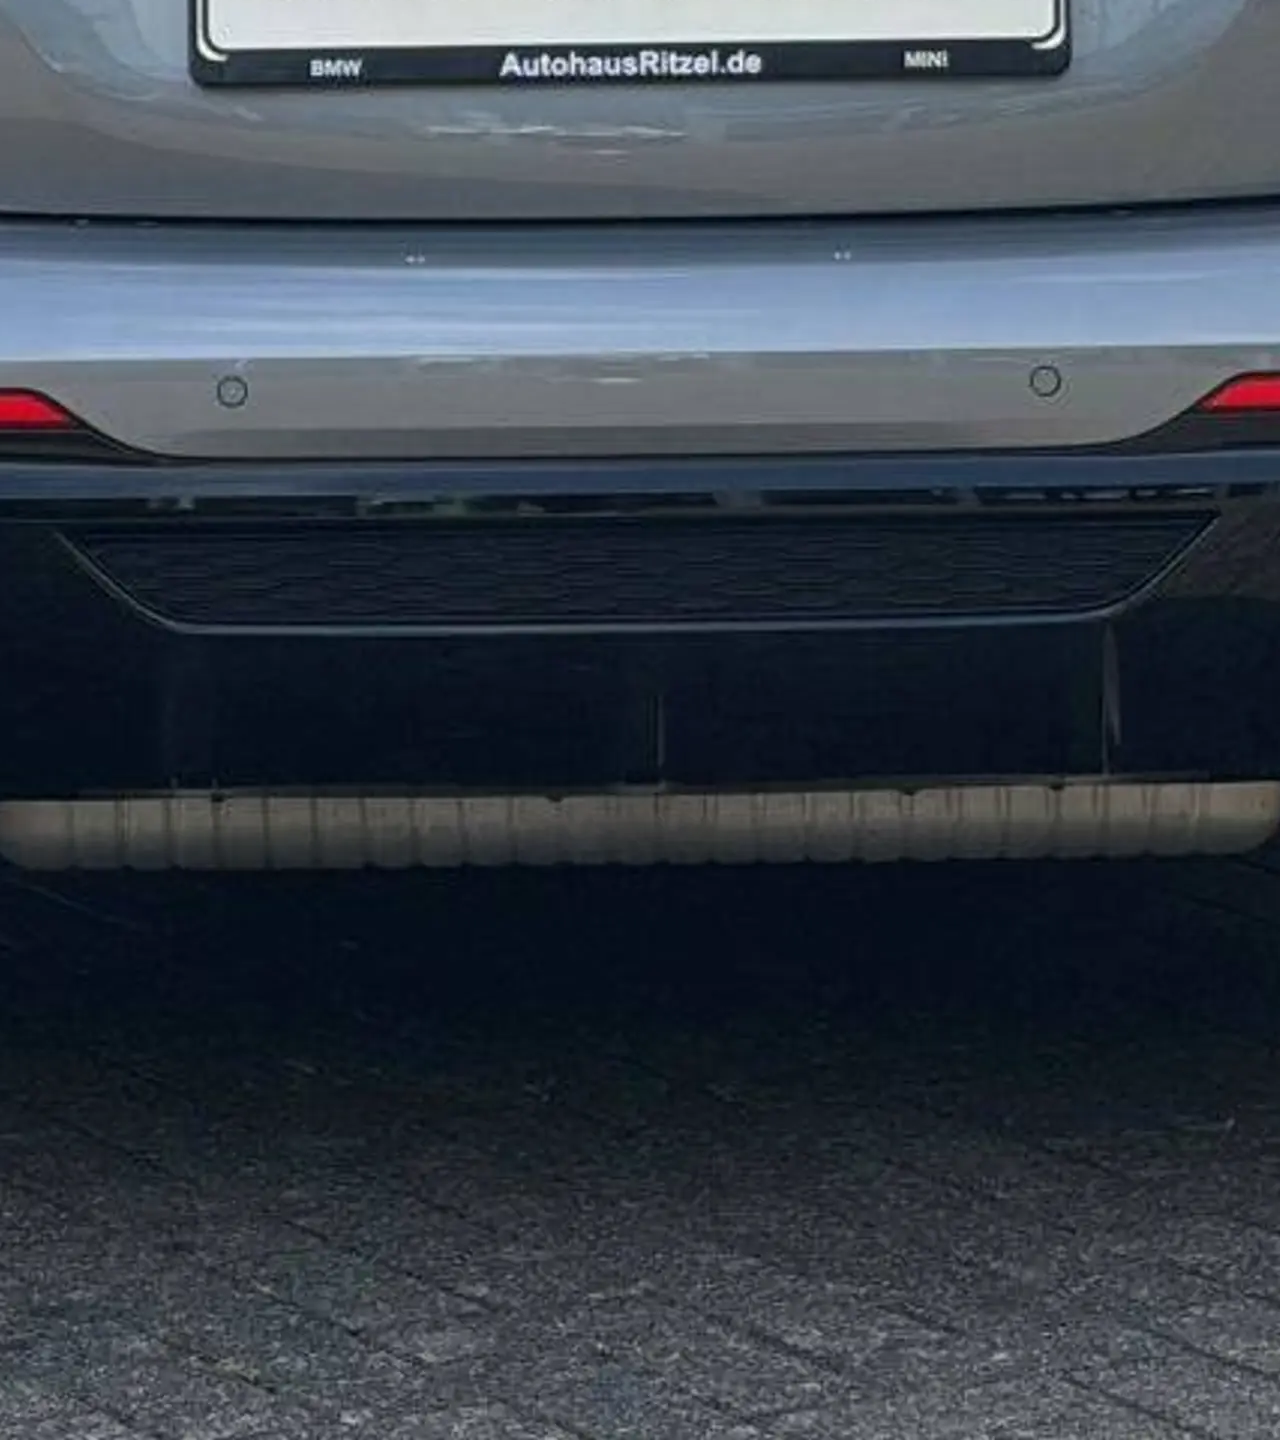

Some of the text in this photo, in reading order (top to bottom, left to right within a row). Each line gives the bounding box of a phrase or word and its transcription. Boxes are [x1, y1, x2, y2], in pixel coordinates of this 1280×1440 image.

[309, 59, 363, 77] BMW
[499, 50, 763, 77] AutohausRitzel.de
[903, 50, 949, 68] MINI
